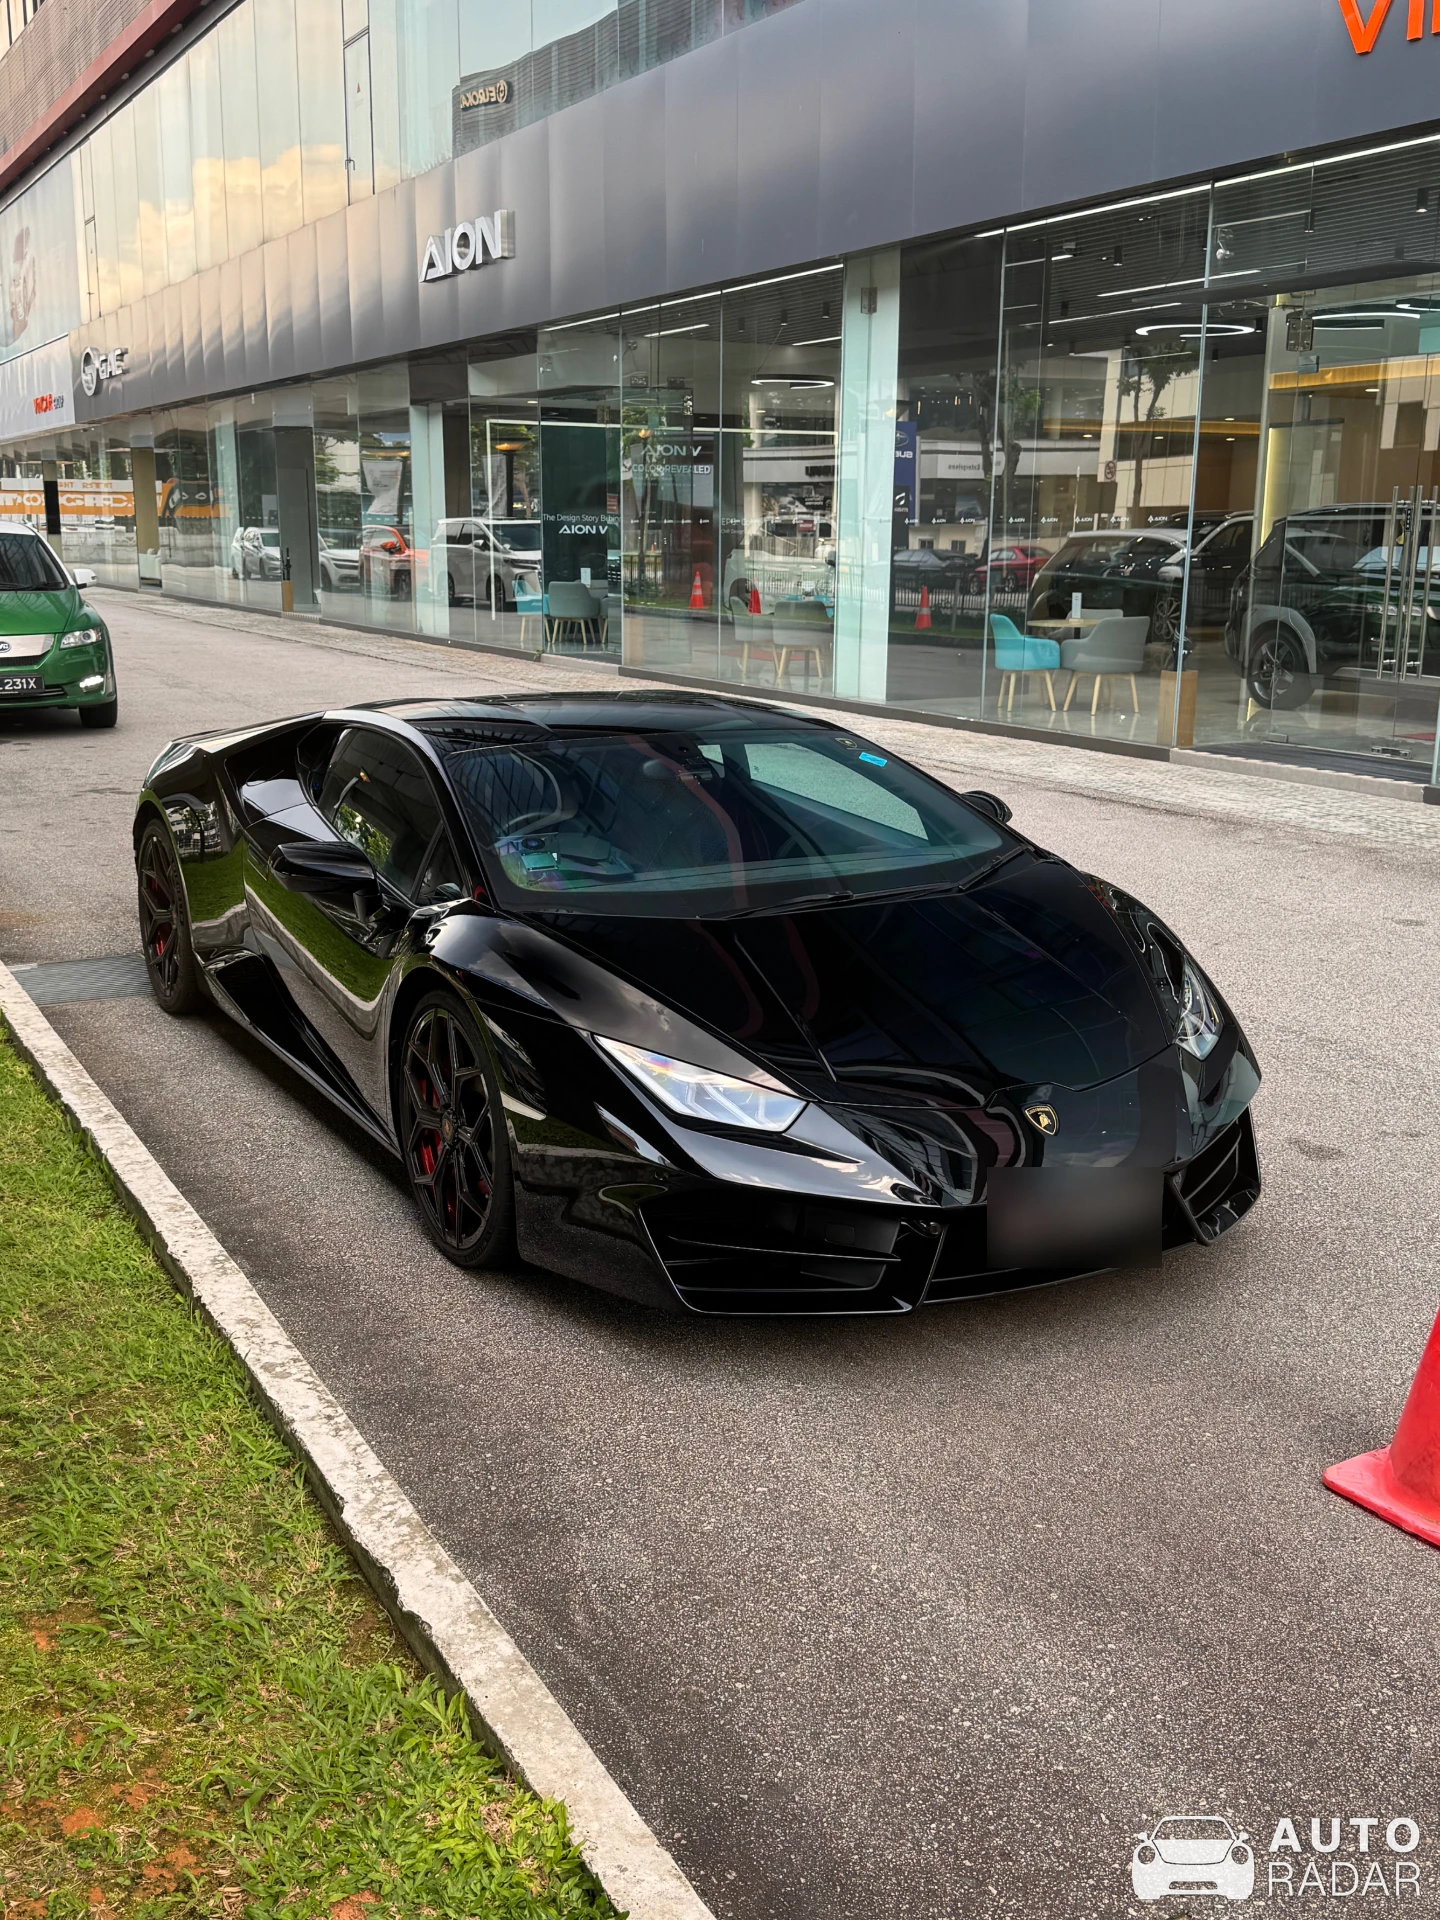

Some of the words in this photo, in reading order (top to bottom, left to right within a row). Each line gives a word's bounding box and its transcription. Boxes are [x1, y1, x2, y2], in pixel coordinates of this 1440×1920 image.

[1336, 0, 1440, 54] VI
[418, 208, 516, 283] AION
[641, 444, 686, 456] AION
[691, 445, 702, 457] V
[664, 464, 711, 474] REVEALED
[543, 513, 556, 521] The
[556, 514, 581, 524] Design
[581, 514, 599, 523] Story
[558, 524, 596, 535] AION
[598, 525, 608, 535] V
